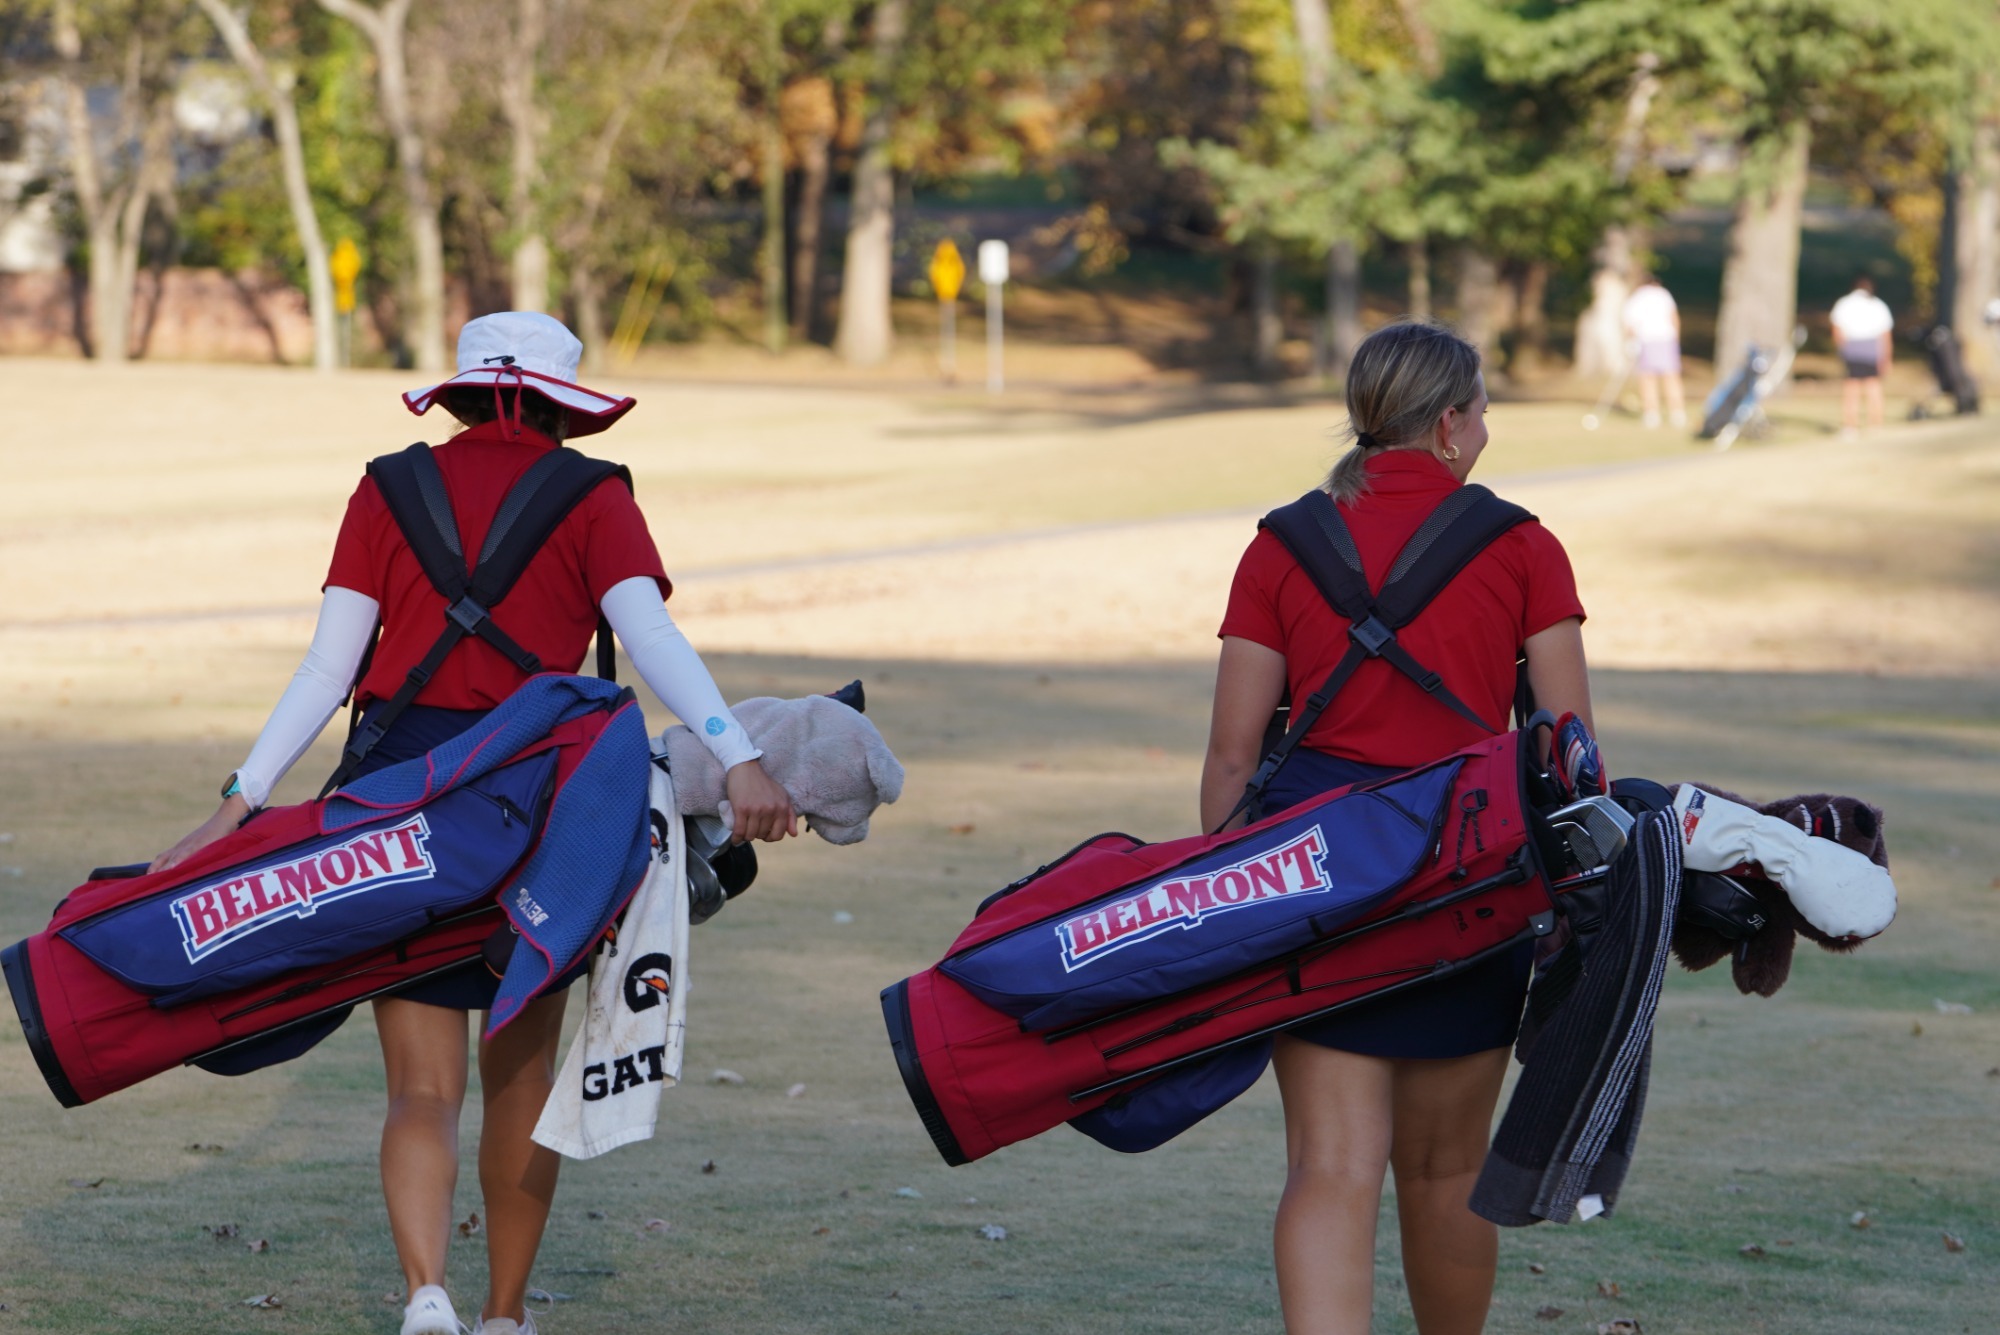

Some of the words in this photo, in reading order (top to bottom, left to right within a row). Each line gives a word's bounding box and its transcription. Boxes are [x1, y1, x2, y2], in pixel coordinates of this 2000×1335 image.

[179, 820, 428, 950] BELMONT
[1065, 832, 1324, 957] BELMONT
[582, 1045, 665, 1102] GAT
